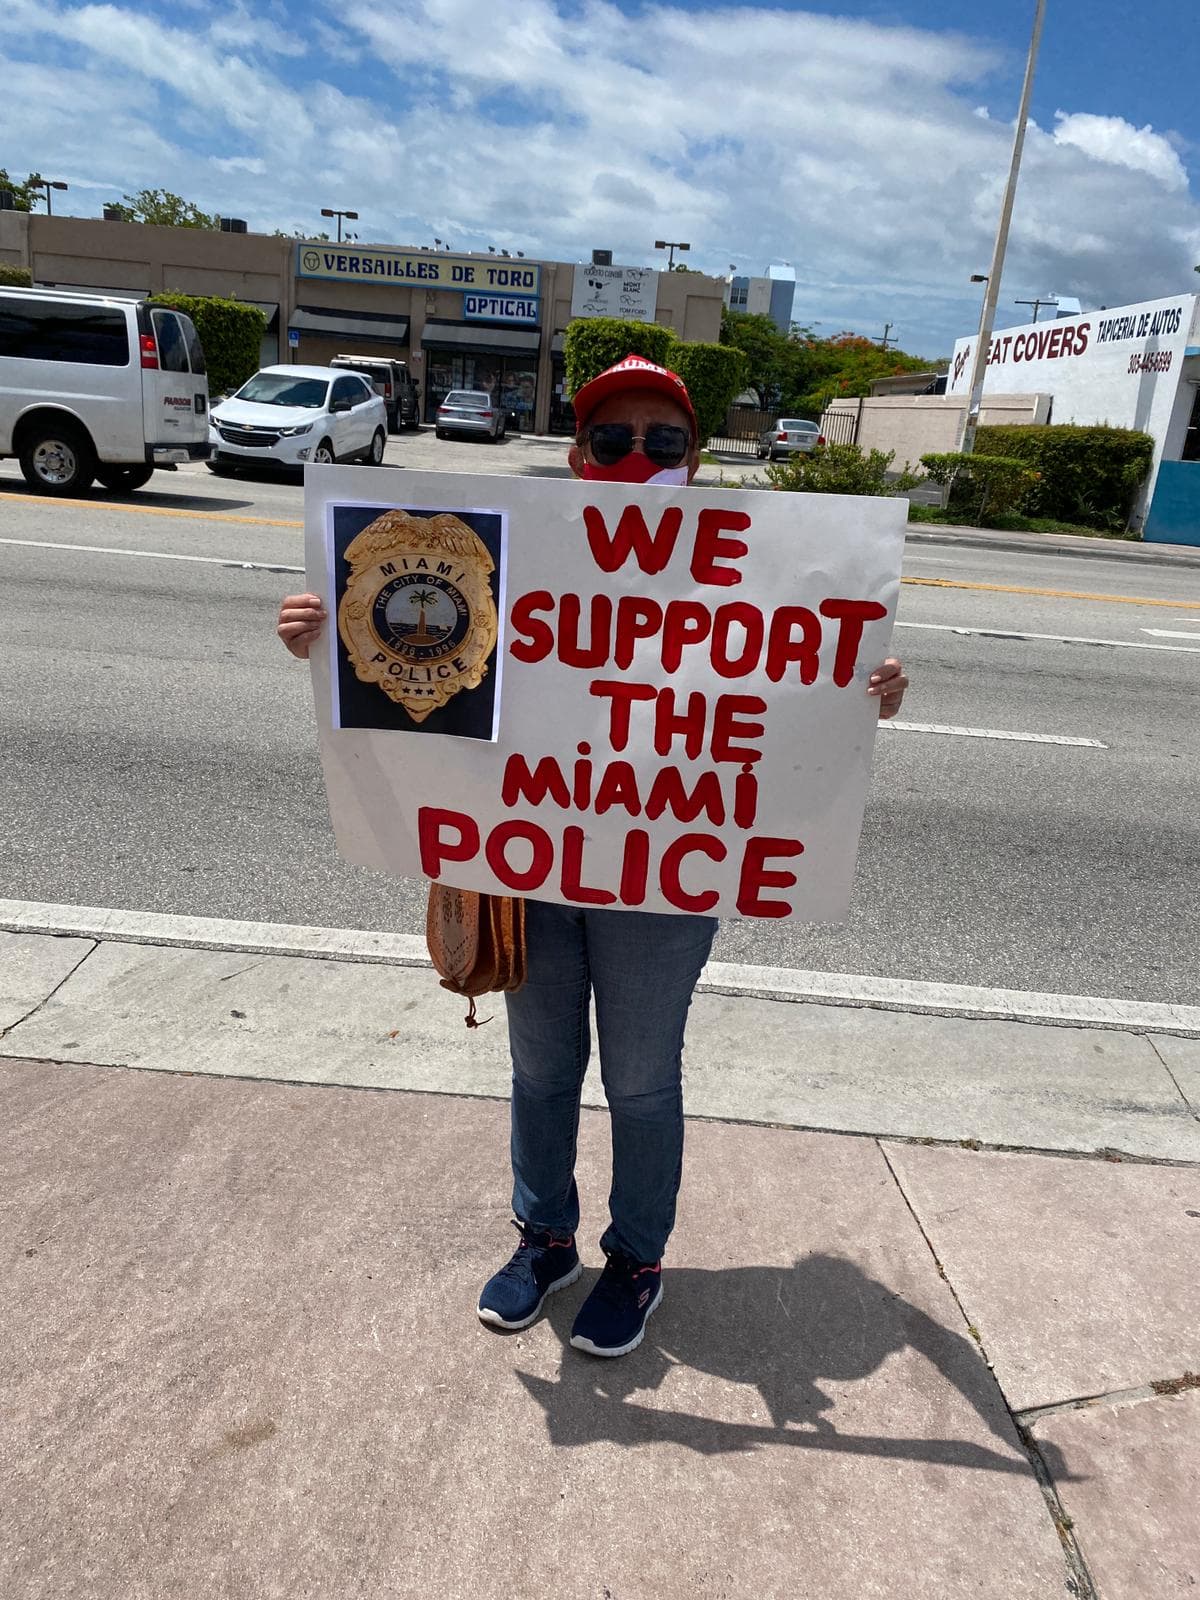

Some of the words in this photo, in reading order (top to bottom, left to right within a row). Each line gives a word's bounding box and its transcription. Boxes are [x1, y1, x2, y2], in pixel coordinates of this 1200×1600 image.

[324, 253, 439, 280] VERSAILLES
[452, 265, 475, 283] DE
[487, 268, 534, 288] TORO
[466, 297, 536, 318] OPTICAL
[1096, 315, 1136, 343] TAPICERIA
[1137, 312, 1150, 338] DE
[1149, 307, 1182, 336] AUTOS
[985, 336, 1013, 366] EAT
[1013, 323, 1091, 363] COVERS
[583, 505, 752, 587] WE
[380, 558, 465, 582] MIAMI
[375, 589, 392, 609] THE
[393, 575, 419, 589] CITY
[426, 576, 443, 587] OF
[445, 586, 468, 616] MIAMI
[509, 590, 887, 688] SUPPORT
[371, 653, 468, 681] POLICE
[590, 680, 768, 763] THE
[418, 807, 805, 918] POLICE
